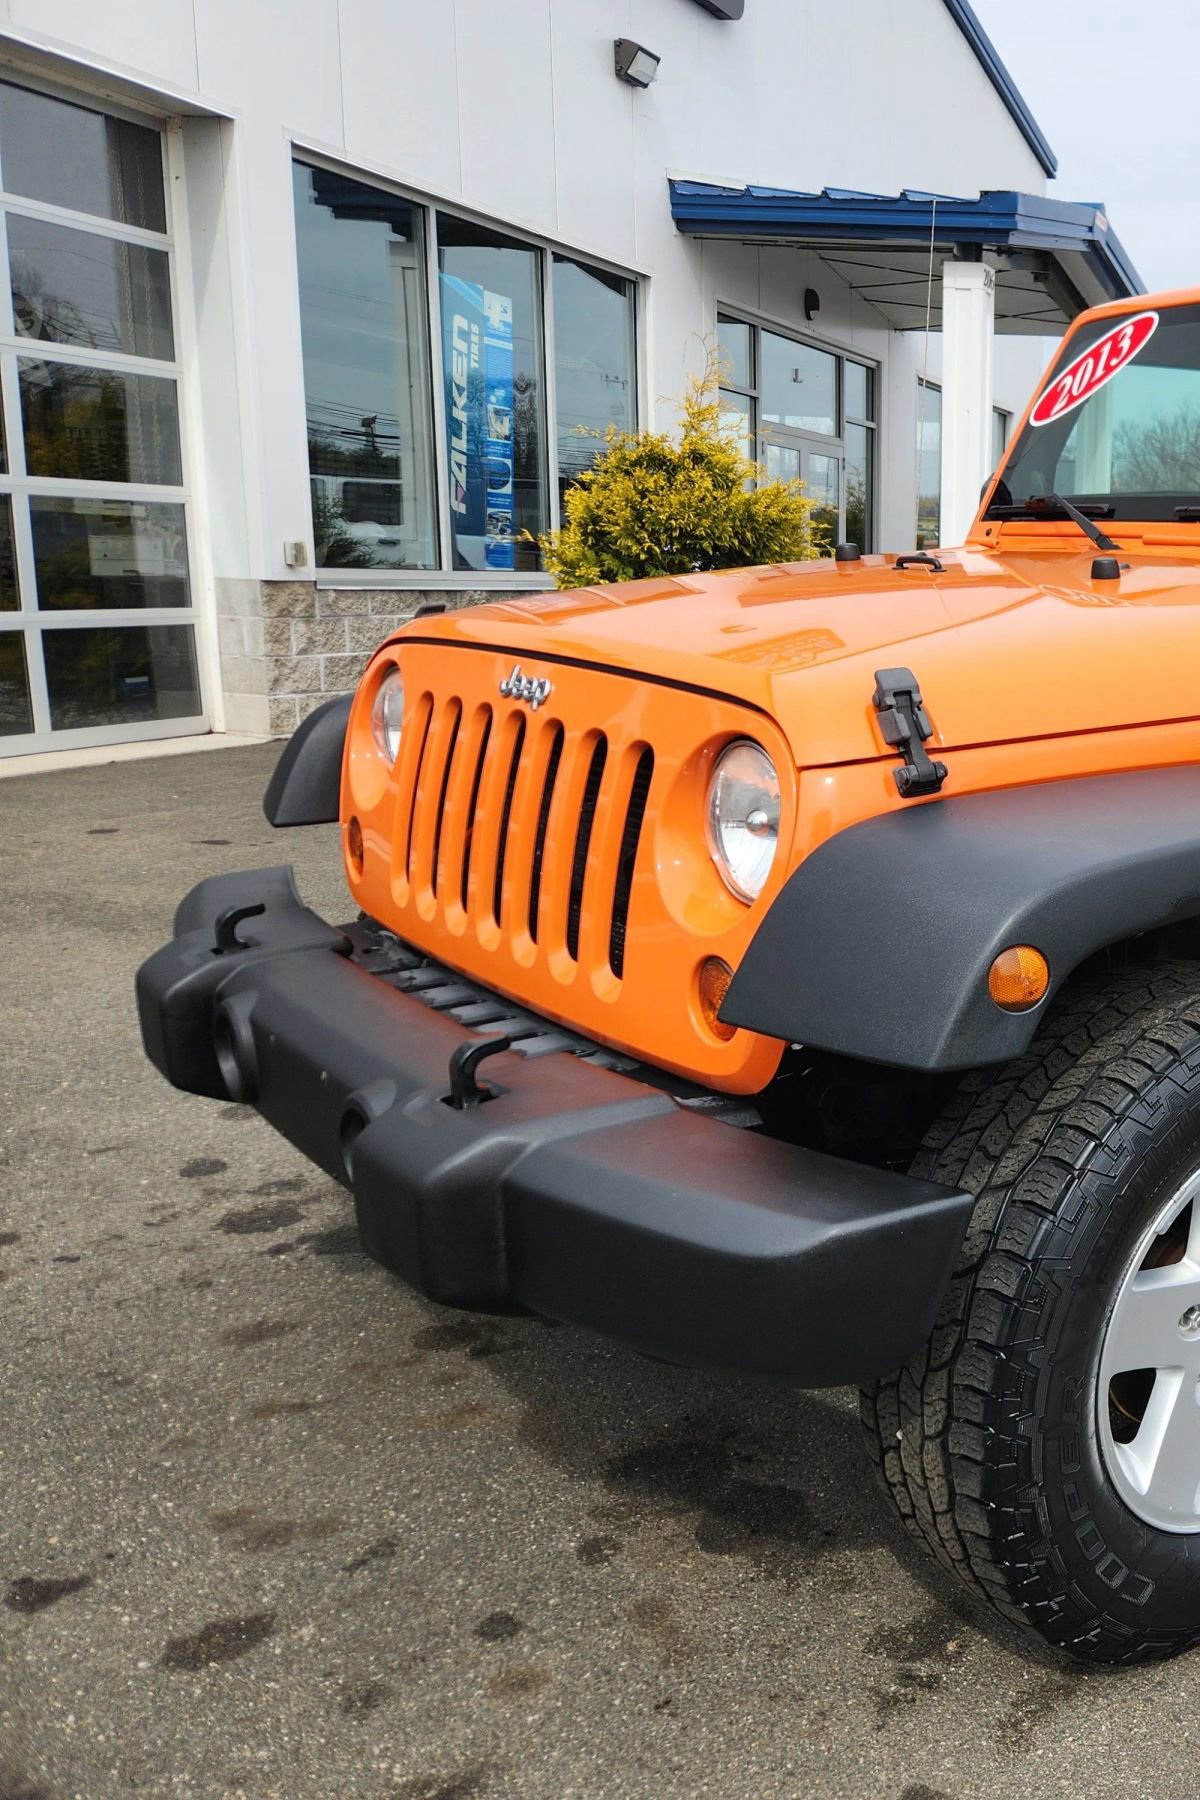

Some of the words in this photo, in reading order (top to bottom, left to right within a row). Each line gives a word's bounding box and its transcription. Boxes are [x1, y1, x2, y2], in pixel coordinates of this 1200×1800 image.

[470, 322, 479, 369] TIRES
[1050, 324, 1135, 418] 2013
[450, 314, 468, 515] FALKEN
[500, 664, 551, 711] Jeep
[1060, 1374, 1155, 1607] COOPER
